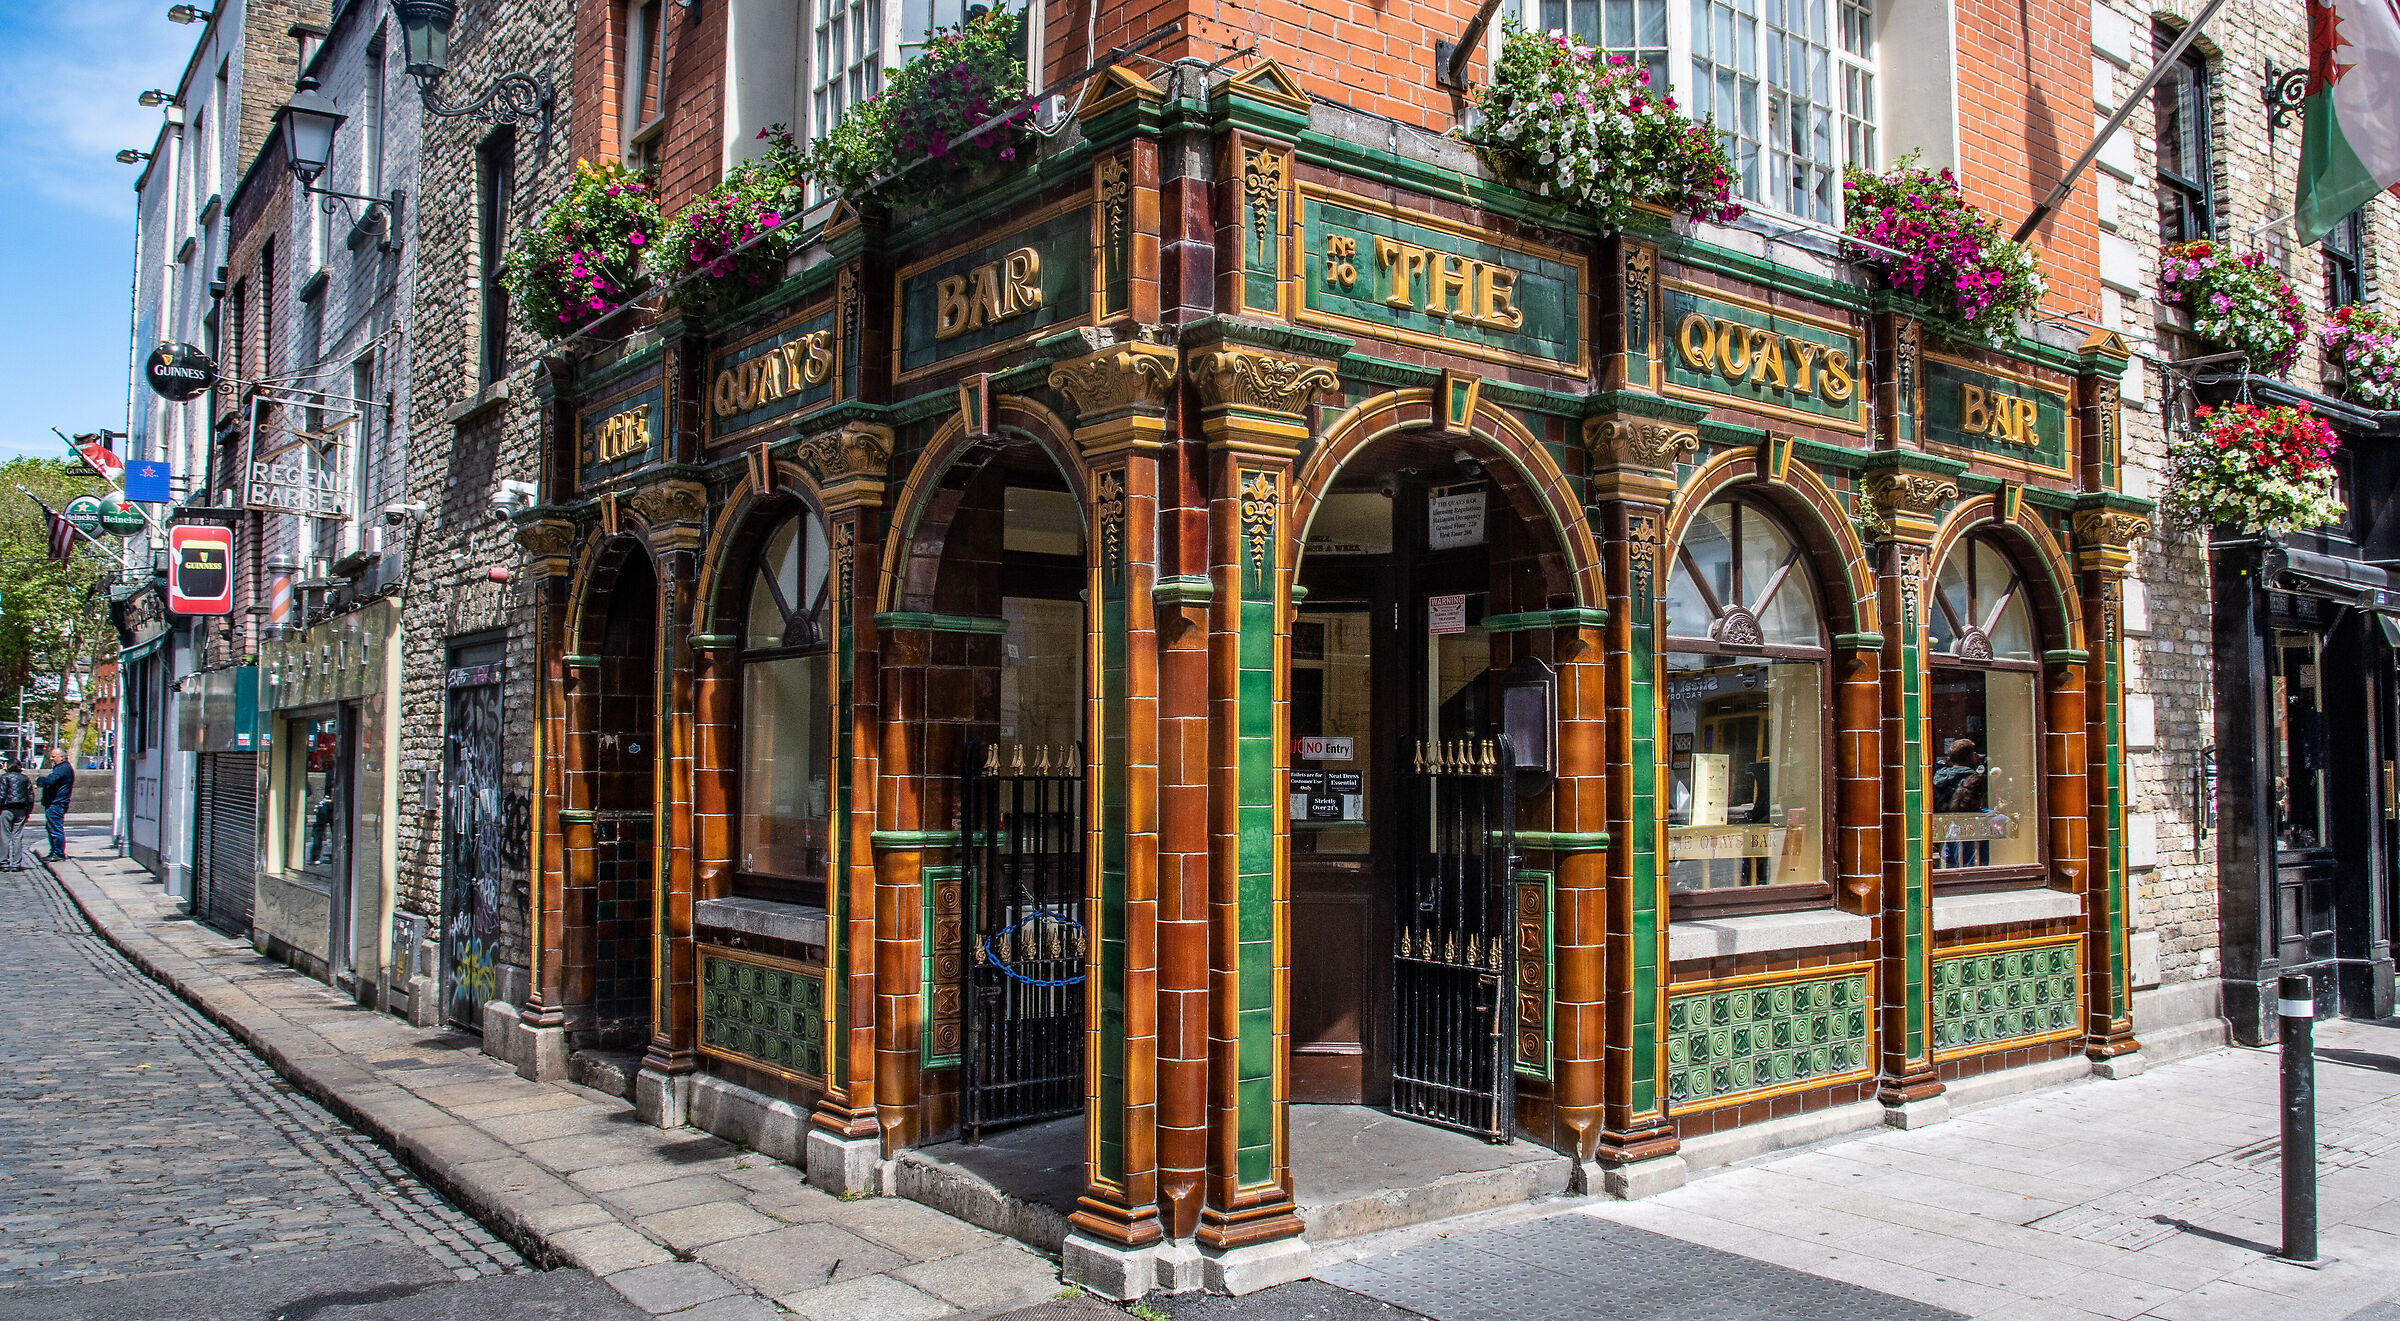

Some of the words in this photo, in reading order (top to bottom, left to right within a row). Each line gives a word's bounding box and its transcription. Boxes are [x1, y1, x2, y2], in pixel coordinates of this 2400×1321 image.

[1375, 235, 1523, 332] THE
[1676, 312, 1853, 401] QUAYS
[1960, 381, 2040, 450] BAR
[597, 403, 651, 464] THE
[713, 329, 833, 418] QUAYS
[936, 247, 1043, 340] BAR
[154, 364, 205, 380] GUINNESS
[66, 467, 99, 475] GUINNES
[252, 461, 350, 492] REGENT
[251, 483, 347, 513] BARBER
[66, 513, 100, 521] Heineke
[103, 515, 145, 525] Heineken
[184, 561, 223, 570] GUINNESS
[1431, 596, 1464, 606] WARNING
[1307, 742, 1323, 753] NO
[1326, 744, 1350, 756] Entry
[1751, 834, 1777, 848] BAR
